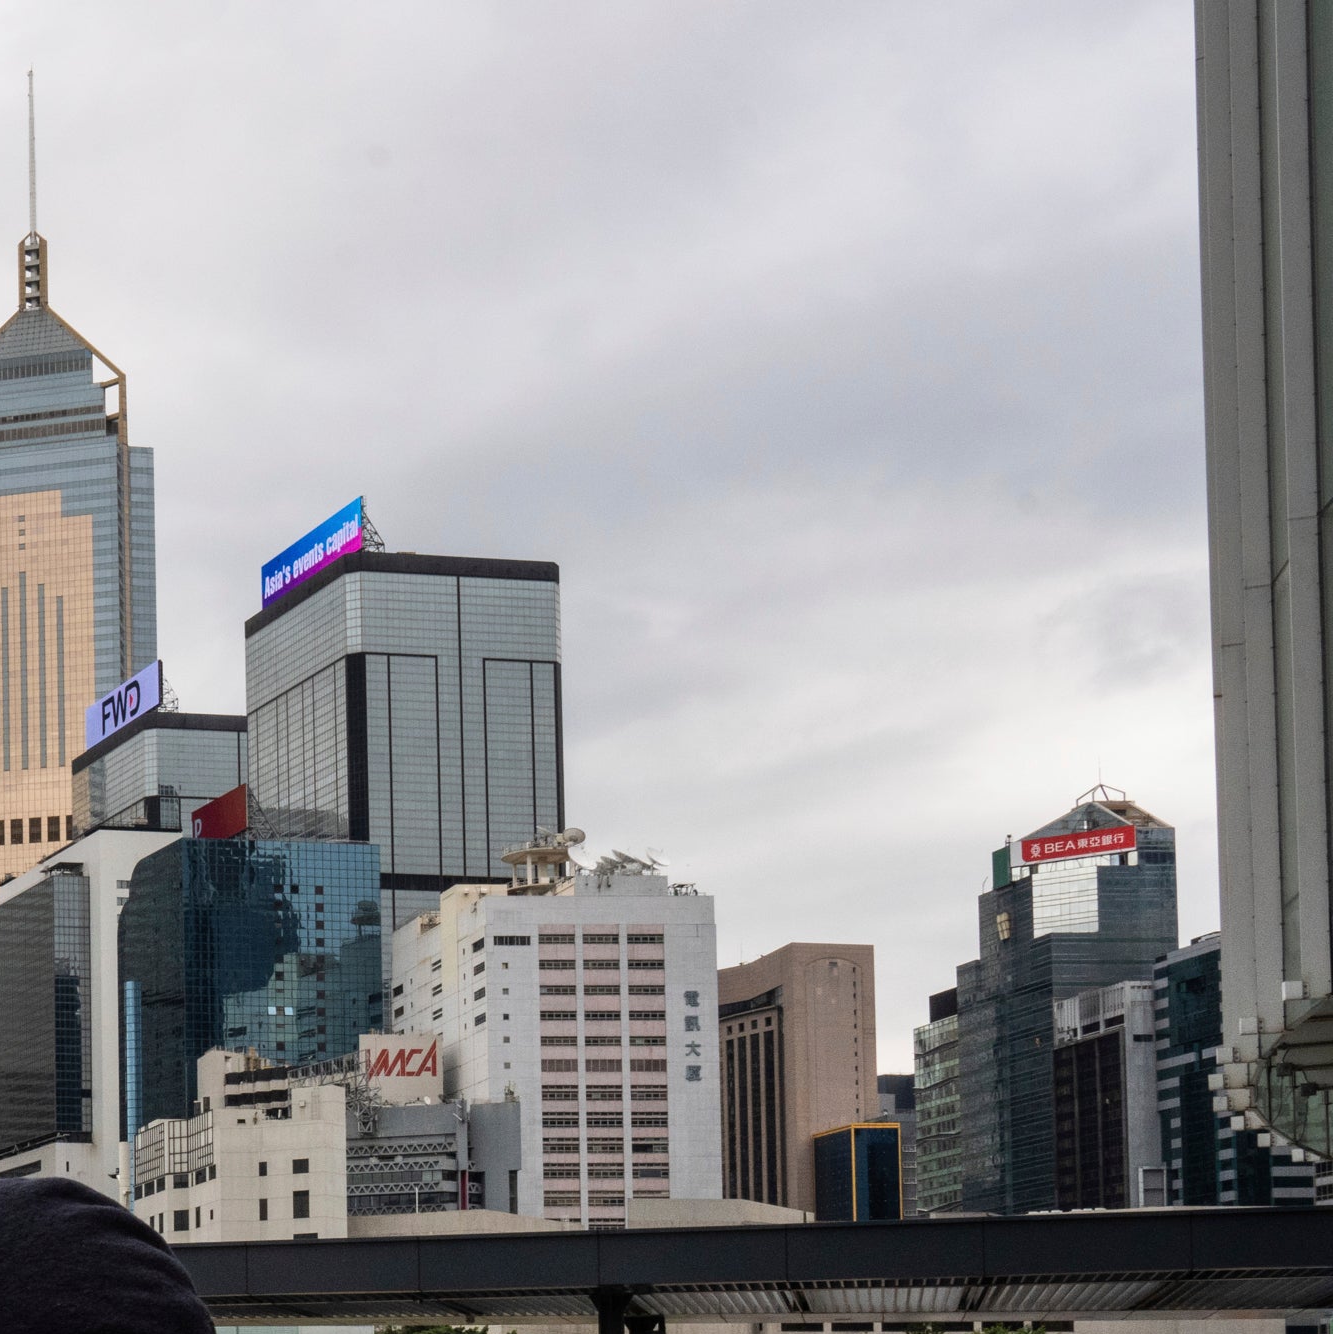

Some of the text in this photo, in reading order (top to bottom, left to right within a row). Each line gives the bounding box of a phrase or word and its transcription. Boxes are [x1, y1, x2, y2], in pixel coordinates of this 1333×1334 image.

[264, 514, 359, 600] Asia's events capital
[101, 680, 141, 736] FWD
[1044, 840, 1076, 854] BEA
[366, 1038, 437, 1082] YMCA
